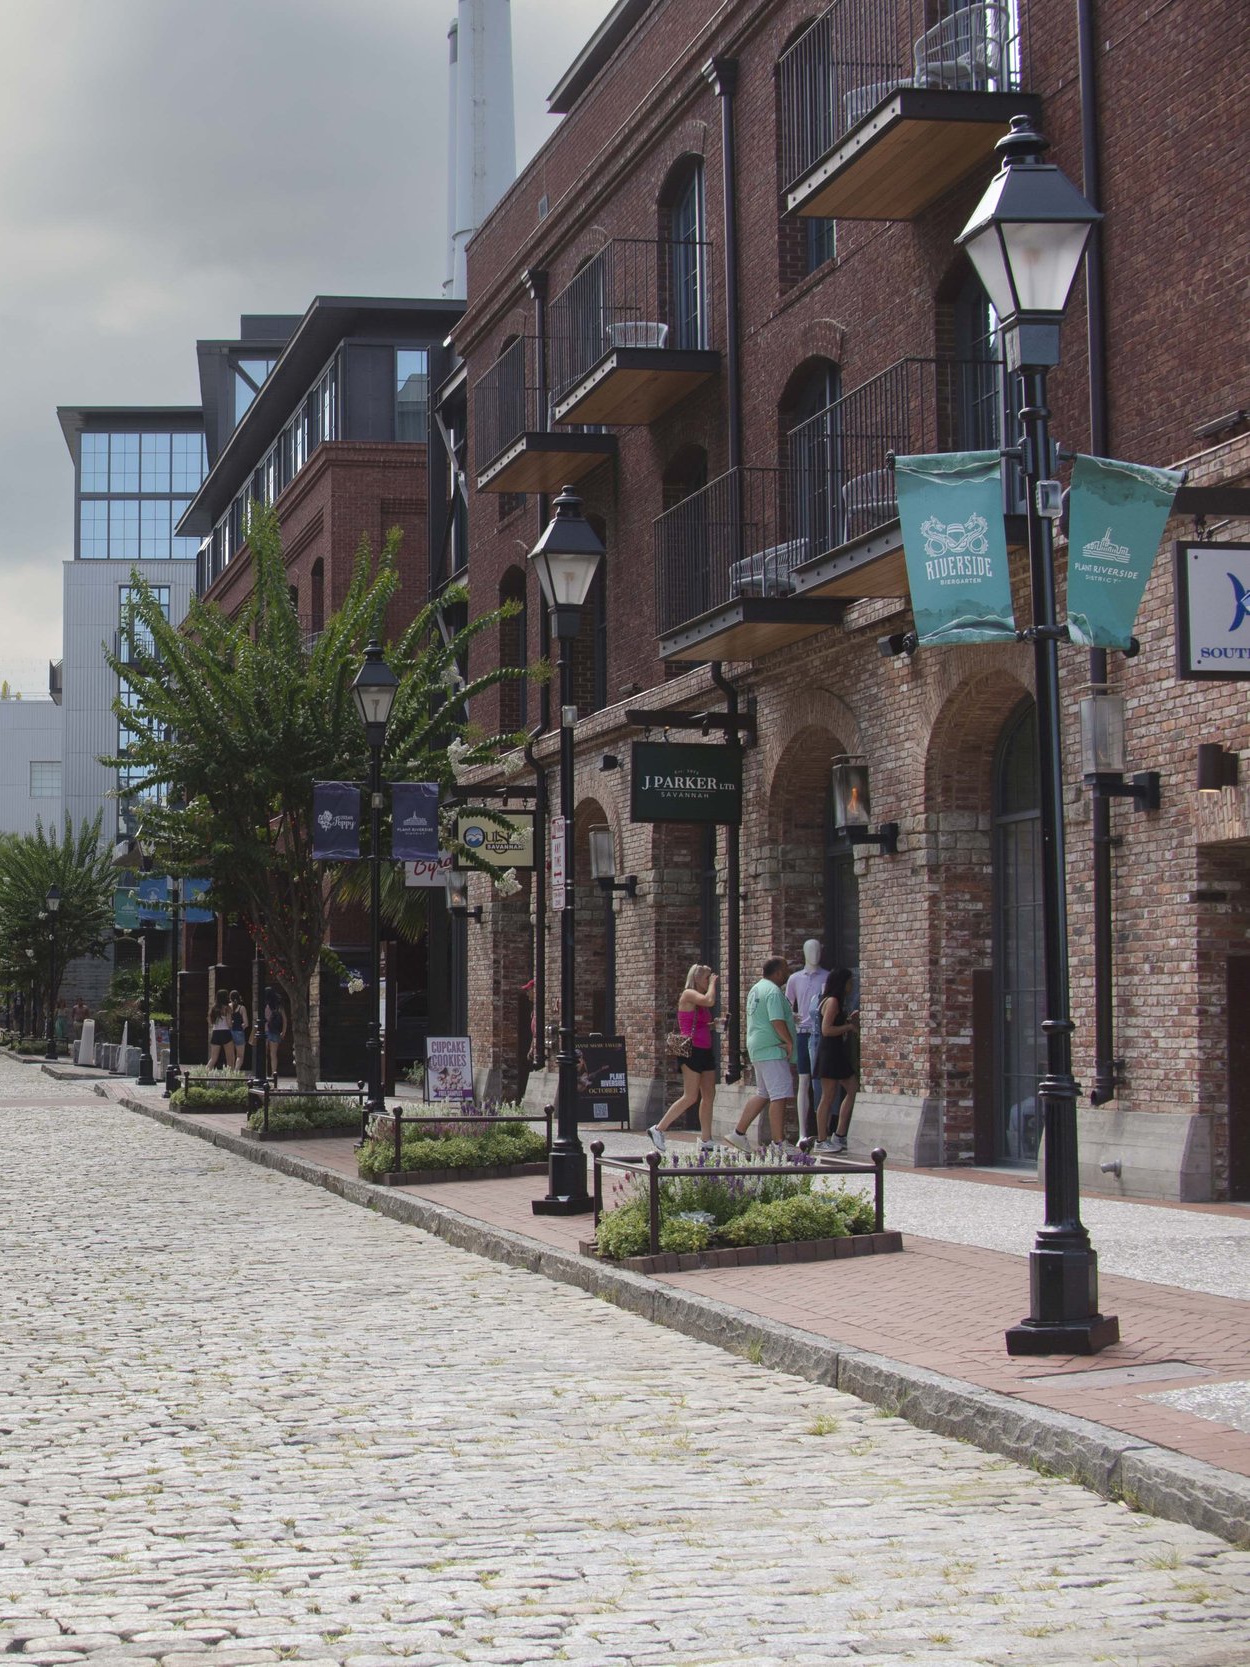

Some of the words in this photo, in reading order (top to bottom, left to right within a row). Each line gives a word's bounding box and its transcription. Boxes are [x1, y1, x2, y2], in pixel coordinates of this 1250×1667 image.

[925, 555, 993, 580] RIVERSIDE
[1074, 562, 1092, 572] PLANT
[1093, 565, 1139, 580] RIVERSIDE
[940, 578, 982, 586] BIERGARTEN
[1085, 574, 1119, 584] DISTRICT
[1200, 647, 1250, 659] SOUT
[653, 776, 718, 790] PARKER
[661, 791, 709, 799] SAVANNAH
[431, 1041, 467, 1054] CUPCAKE
[432, 1054, 467, 1067] COOKIES
[609, 1072, 626, 1080] PLANT
